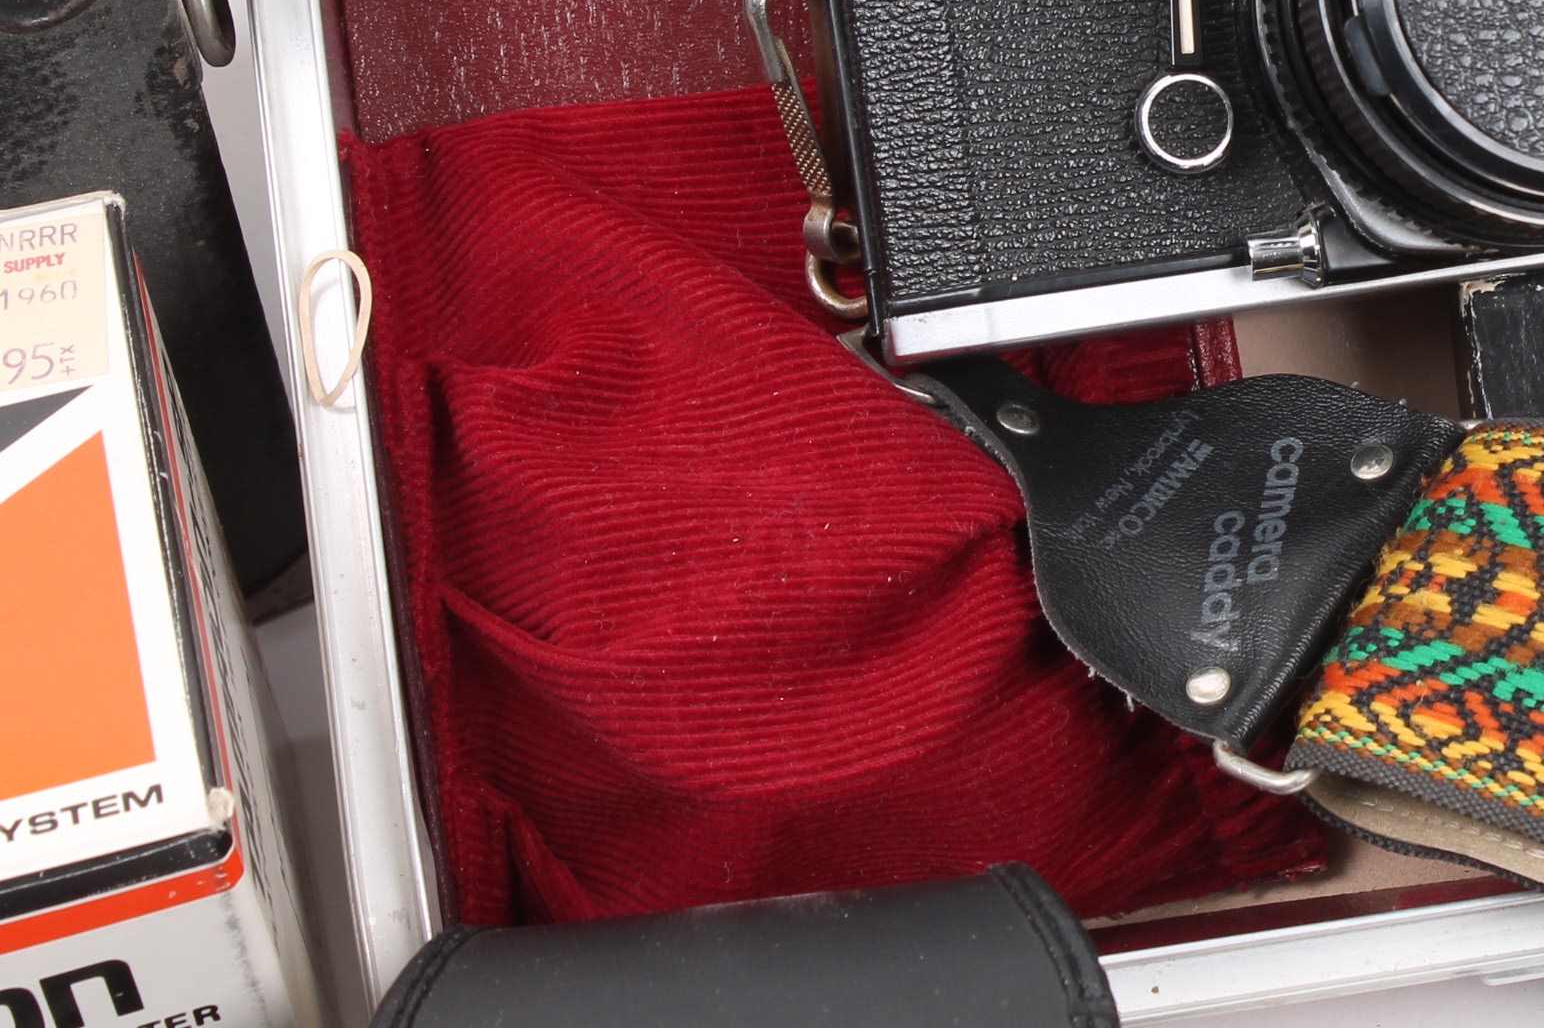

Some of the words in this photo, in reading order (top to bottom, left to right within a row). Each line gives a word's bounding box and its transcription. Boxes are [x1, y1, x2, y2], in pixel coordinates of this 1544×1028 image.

[3, 252, 66, 274] SUPPLY
[1247, 436, 1304, 583] camera
[1191, 510, 1246, 652] caddy
[0, 783, 164, 843] YSTEM
